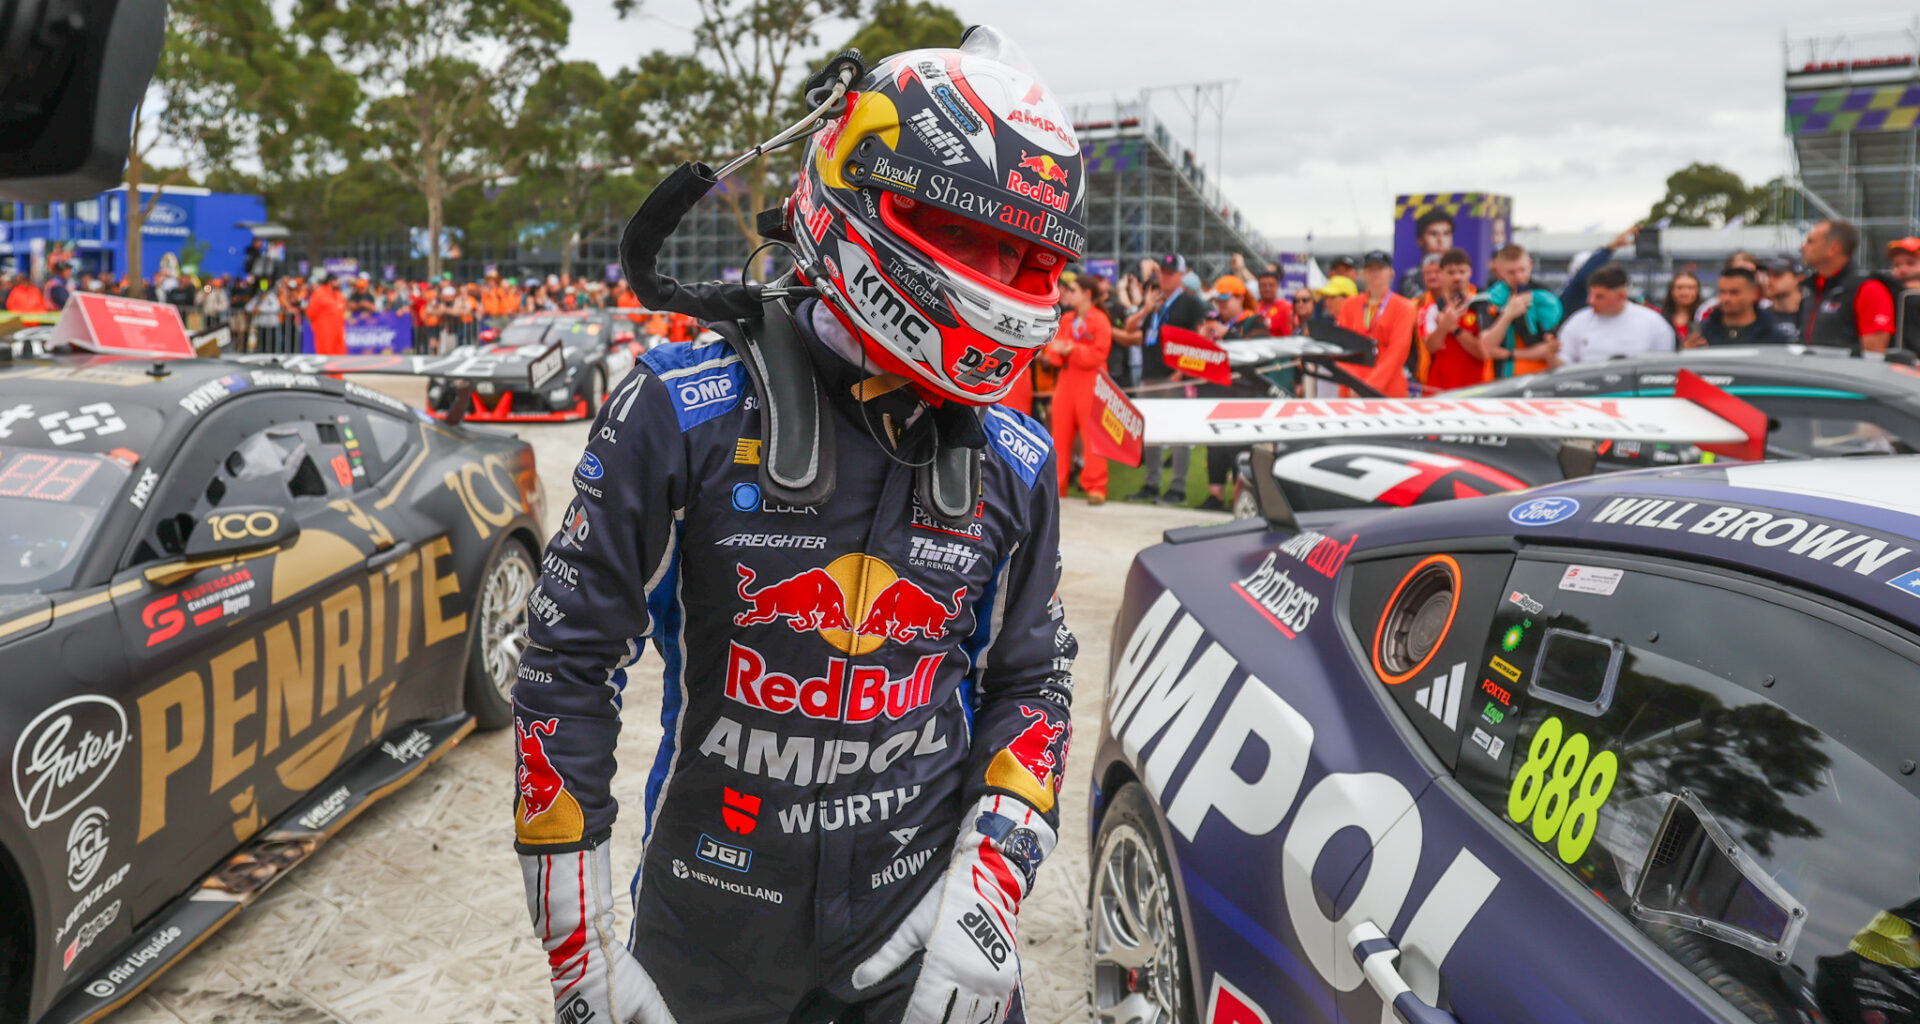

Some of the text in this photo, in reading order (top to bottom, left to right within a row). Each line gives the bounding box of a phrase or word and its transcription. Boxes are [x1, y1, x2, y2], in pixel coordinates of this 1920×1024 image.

[906, 119, 939, 156] CAR RENTAL
[909, 107, 971, 167] Thrifty
[1006, 109, 1077, 151] AMPOL
[873, 156, 922, 187] Blygold
[888, 257, 939, 309] TRAEGER
[848, 285, 914, 353] WHEELS
[998, 313, 1028, 333] XF
[957, 347, 1012, 378] DPO
[680, 377, 733, 405] OMP
[999, 428, 1039, 466] OMP
[130, 468, 158, 509] HRX
[573, 475, 603, 498] CING
[208, 511, 279, 541] 100
[911, 505, 983, 537] Pars
[1518, 500, 1563, 521] Ford
[908, 536, 981, 575] Thrifty
[1593, 497, 1912, 577] WILL BROWN
[908, 558, 956, 572] CAR RENTAL
[187, 579, 255, 612] CHAMPIONSHIP
[1238, 551, 1319, 632] Partners
[136, 536, 467, 844] PENRITE
[1481, 678, 1512, 706] FOXTEL
[698, 715, 949, 787] AMPOL
[25, 714, 122, 829] Gates
[1506, 716, 1618, 864] 888
[777, 784, 922, 834] WÜRTH
[67, 826, 109, 871] ACL
[700, 840, 748, 868] JGI
[64, 863, 131, 935] DUNLOP
[691, 870, 784, 905] NEW HOLLAND
[107, 926, 182, 984] Air Liquide
[963, 910, 1007, 966] OMP
